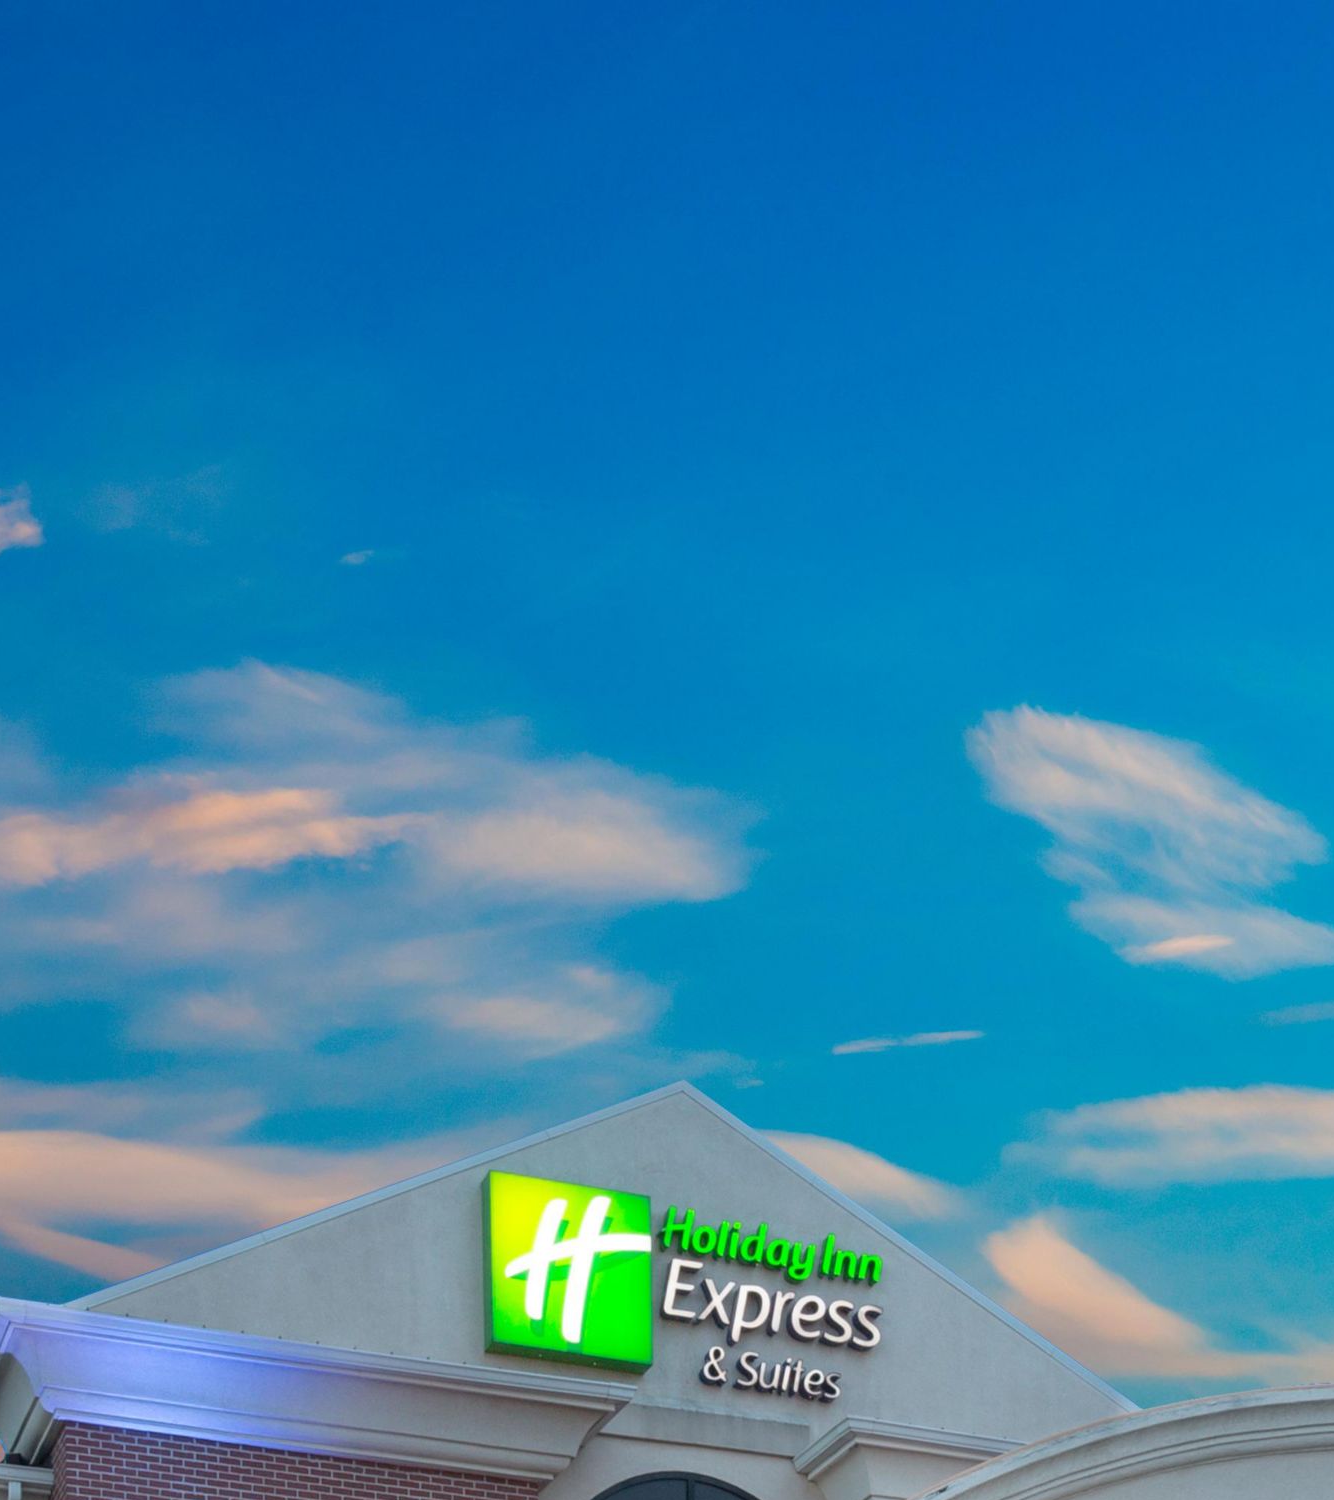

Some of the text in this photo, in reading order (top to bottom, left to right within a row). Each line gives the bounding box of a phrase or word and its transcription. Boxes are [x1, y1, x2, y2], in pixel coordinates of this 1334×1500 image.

[663, 1205, 883, 1284] Holiday Inn
[662, 1259, 883, 1348] Express
[701, 1345, 842, 1399] & Suites
